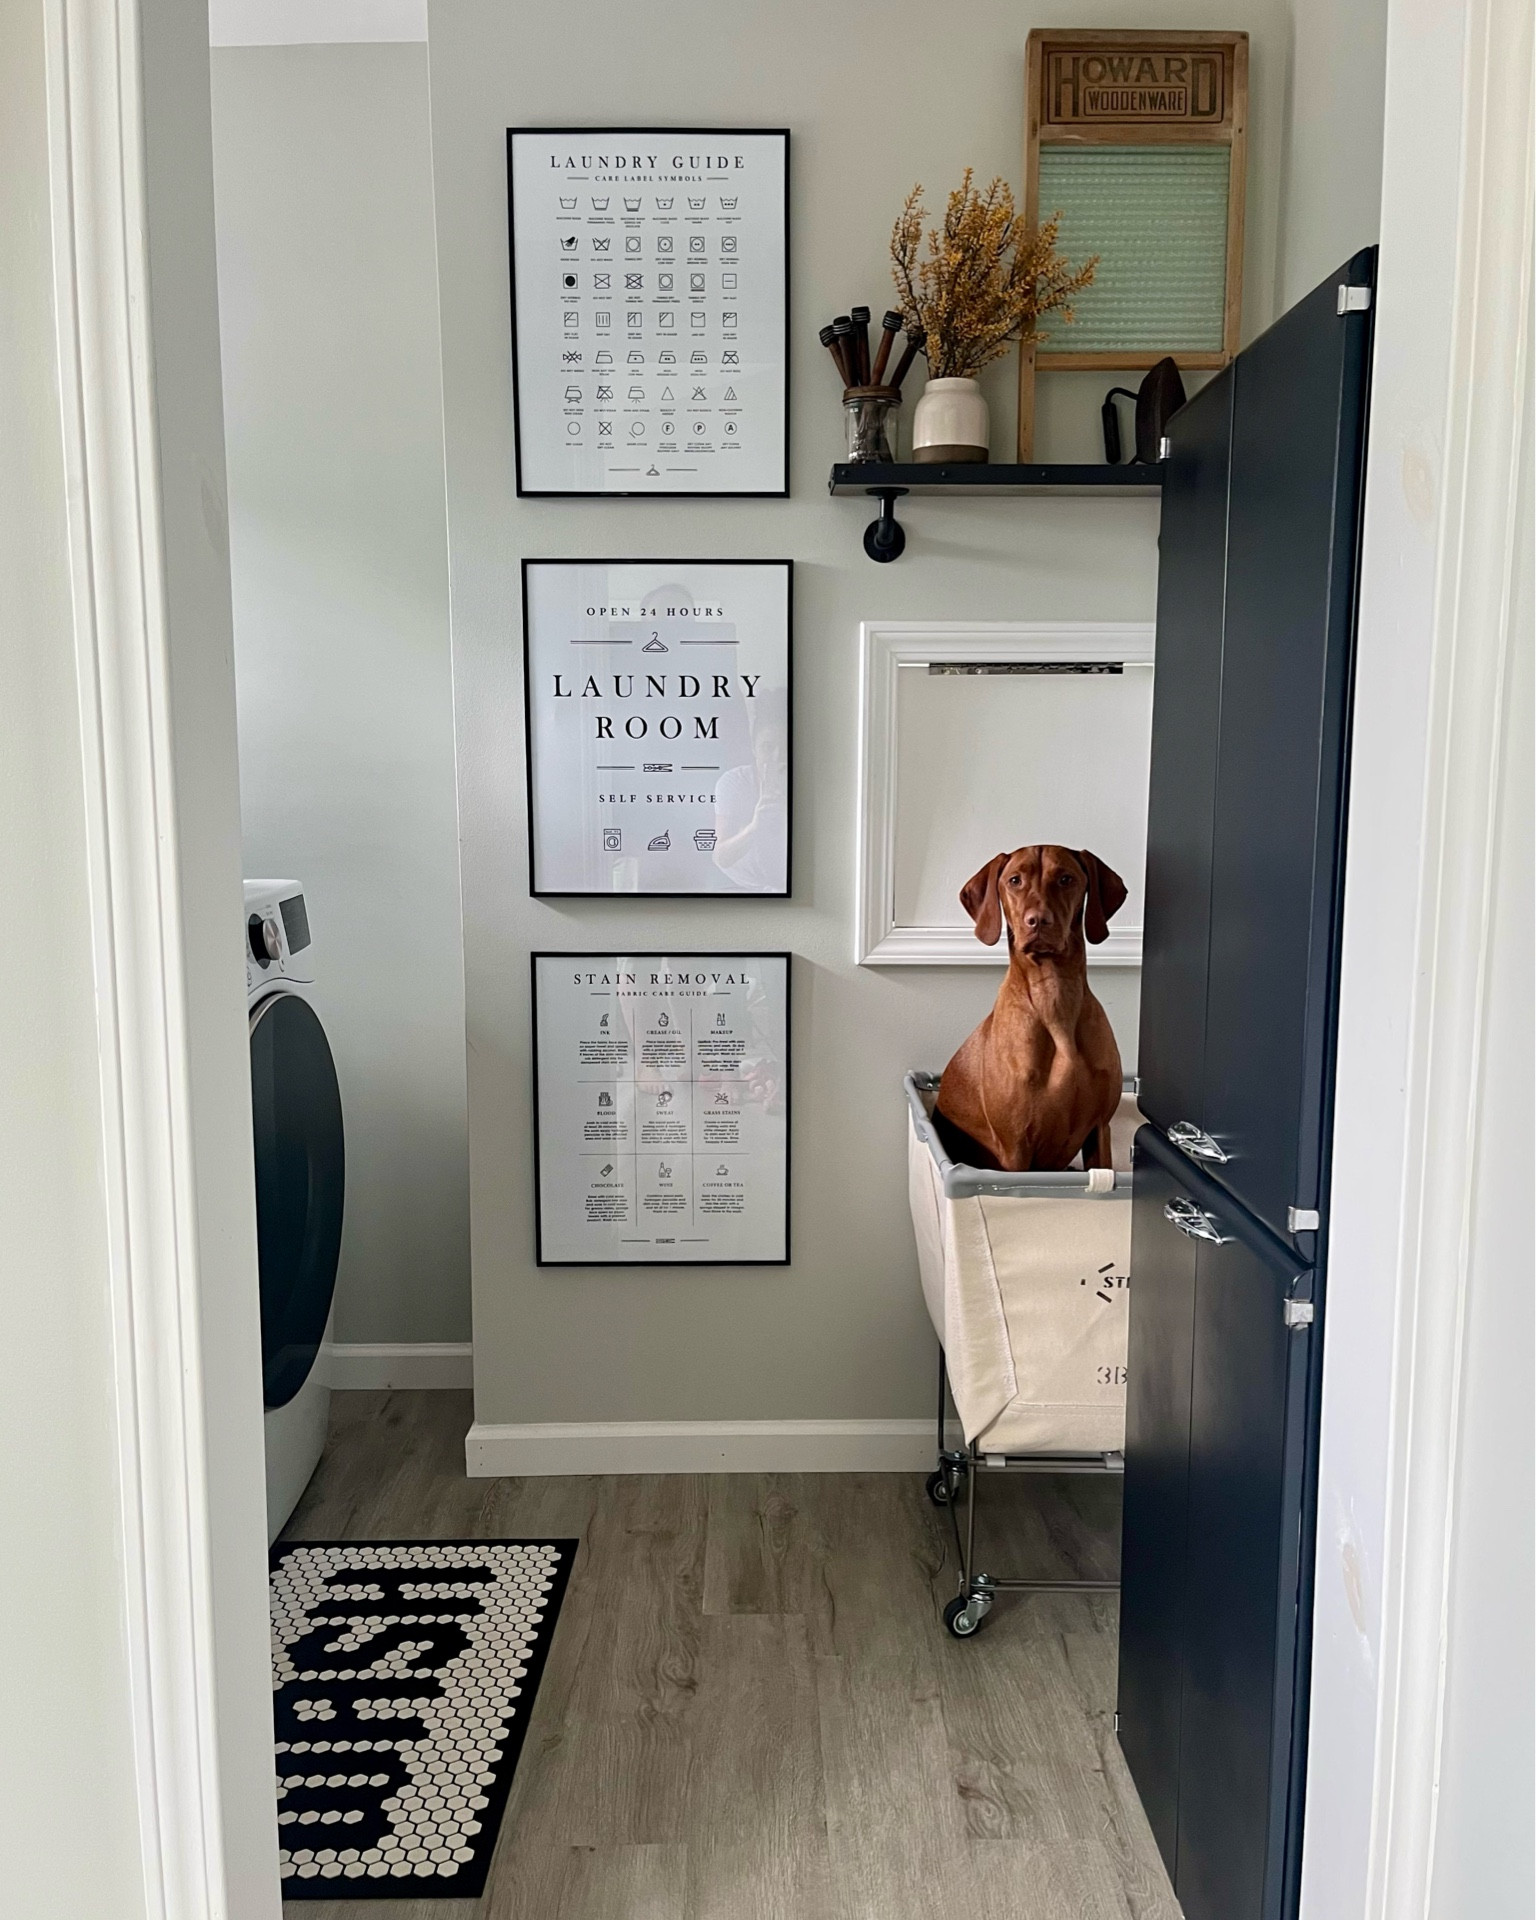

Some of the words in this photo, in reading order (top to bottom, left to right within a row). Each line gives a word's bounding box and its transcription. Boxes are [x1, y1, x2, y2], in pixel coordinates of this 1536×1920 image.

[1054, 56, 1217, 118] HOWARD
[1088, 90, 1184, 112] WOODENWARE
[550, 155, 659, 169] LAUNDRY
[672, 155, 745, 169] GUIDE
[658, 175, 703, 183] SYMBOLS
[586, 606, 631, 617] OPEN
[640, 607, 657, 617] 24
[666, 607, 724, 617] HOURS
[552, 674, 762, 699] LAUNDRY
[595, 716, 720, 740] ROOM
[598, 793, 638, 803] SELF
[646, 793, 717, 804] SERVICE
[573, 973, 637, 985] STAIN
[650, 973, 751, 985] REMOVAL
